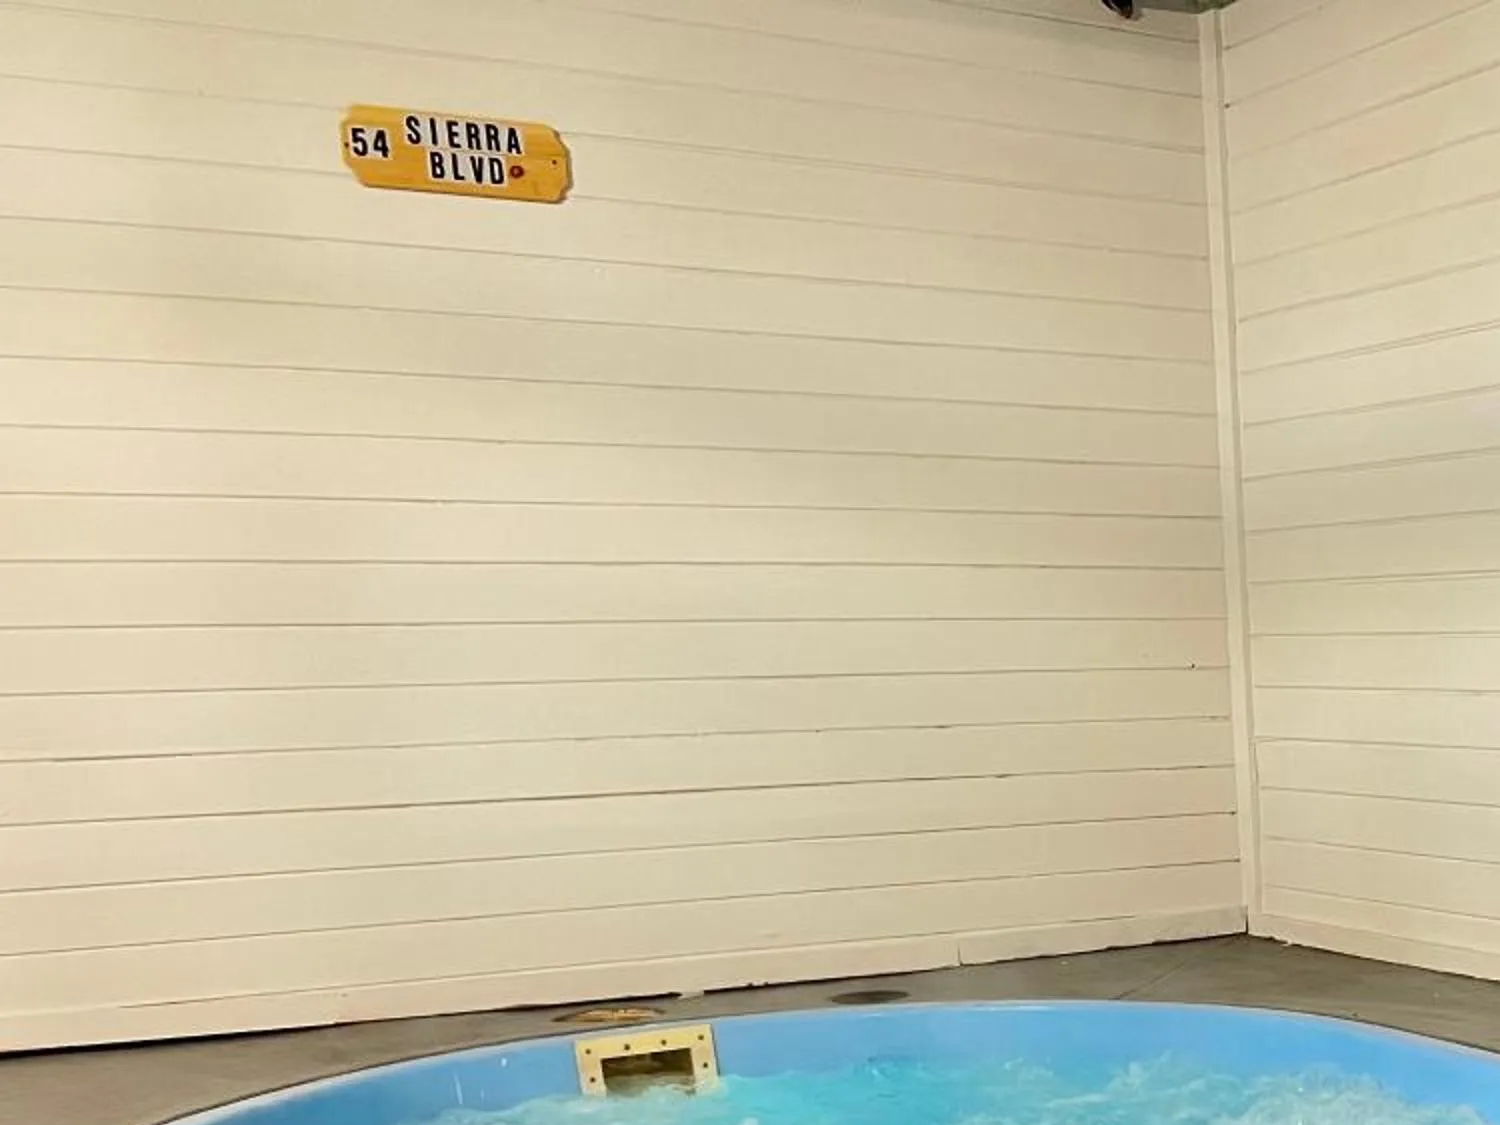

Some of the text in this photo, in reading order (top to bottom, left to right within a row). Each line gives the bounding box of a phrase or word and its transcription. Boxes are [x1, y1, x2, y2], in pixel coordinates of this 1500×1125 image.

[351, 115, 522, 158] 54 SIERRA
[429, 151, 505, 185] BLVD
